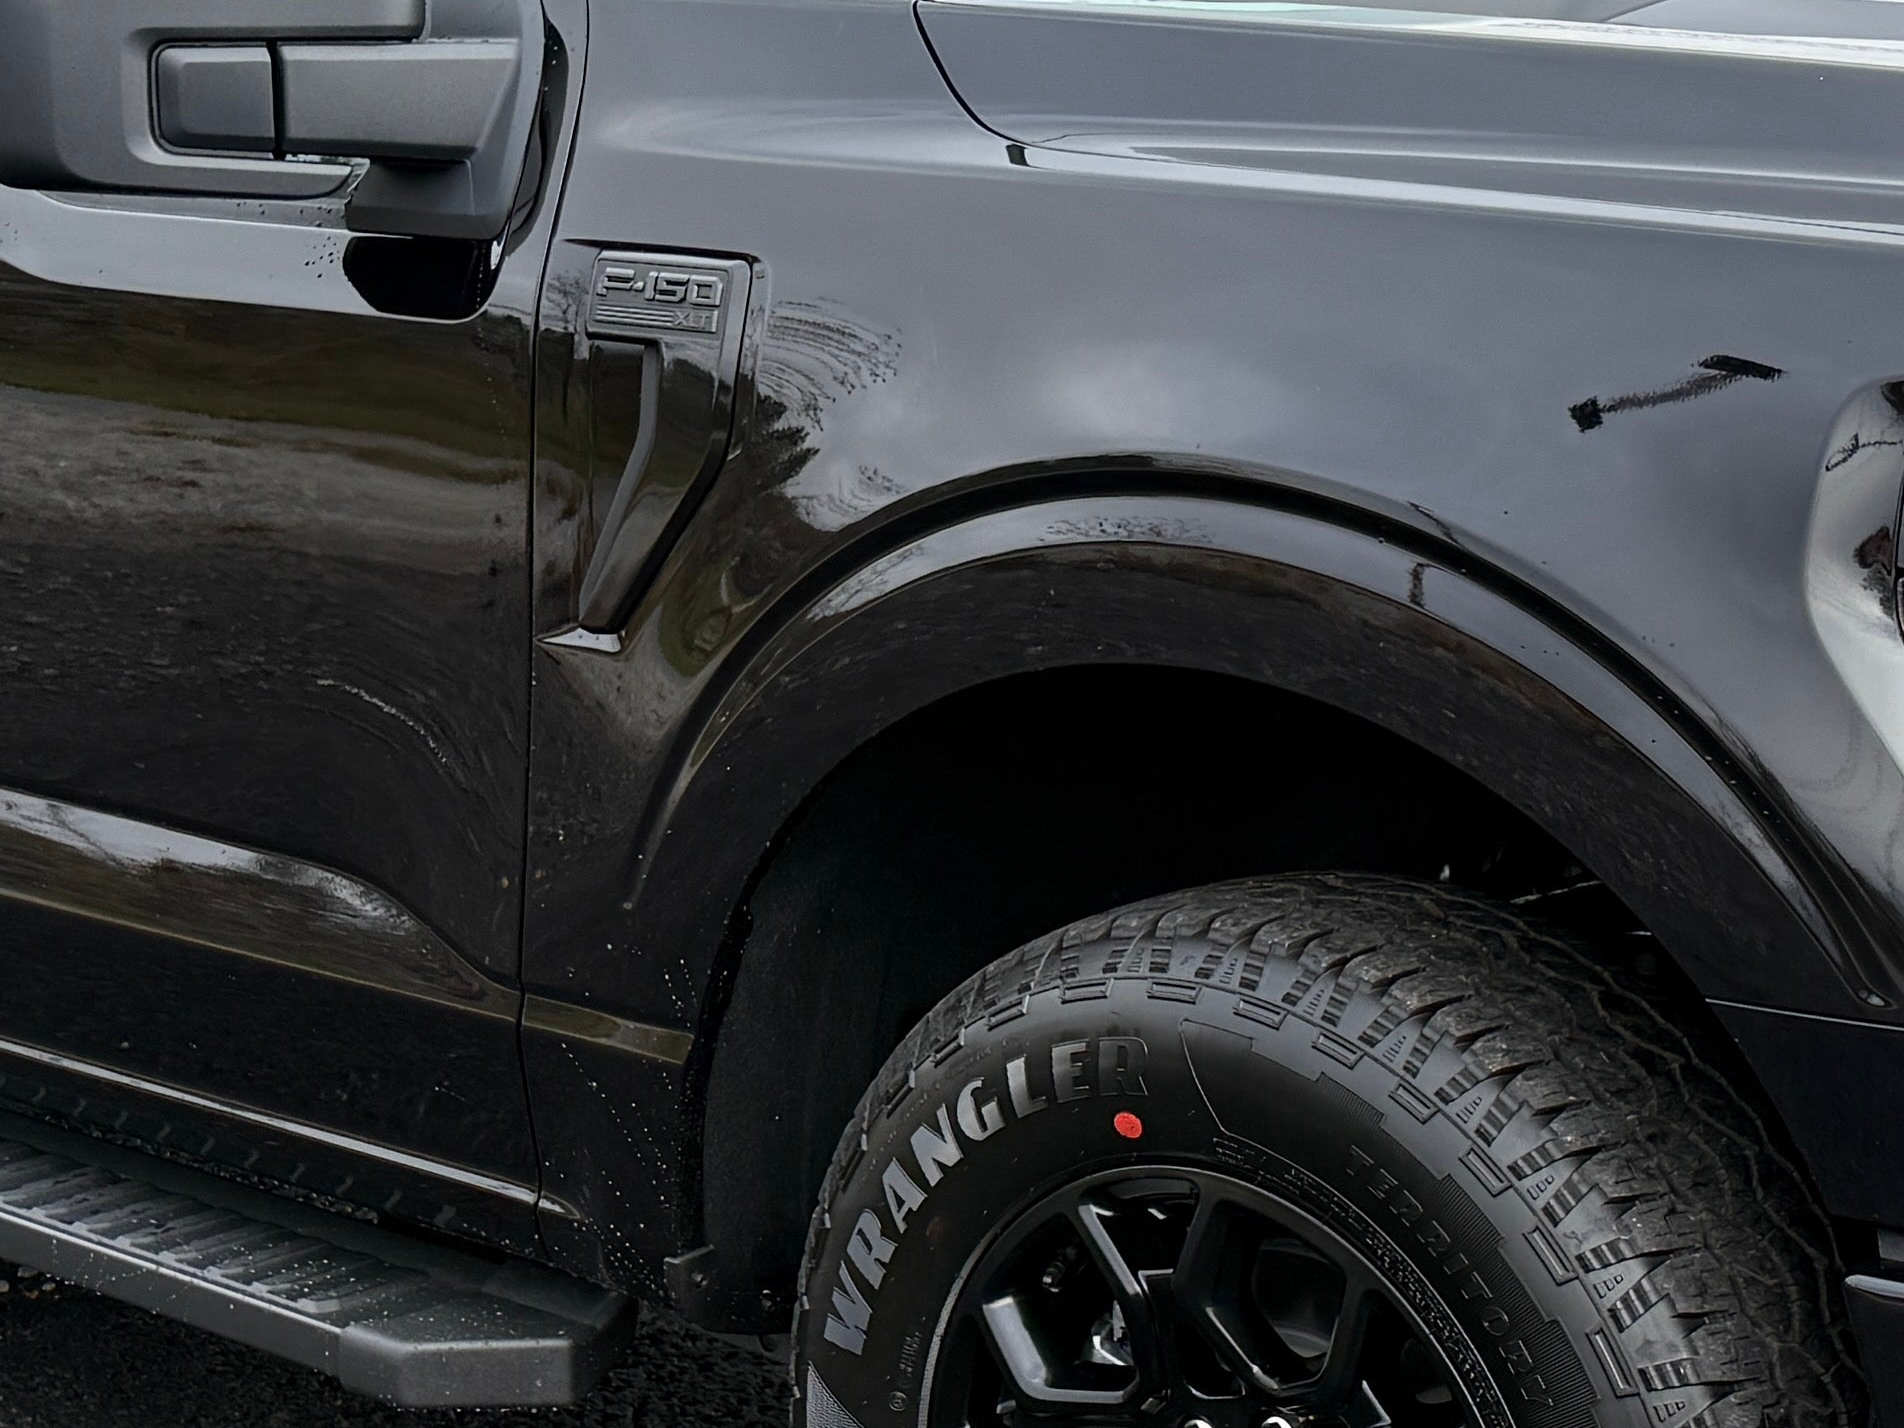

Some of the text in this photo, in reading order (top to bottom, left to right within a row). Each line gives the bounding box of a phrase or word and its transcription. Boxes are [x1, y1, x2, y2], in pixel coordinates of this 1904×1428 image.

[597, 268, 722, 306] F-150
[673, 311, 711, 328] XLT
[823, 1036, 1149, 1356] WRANGLER
